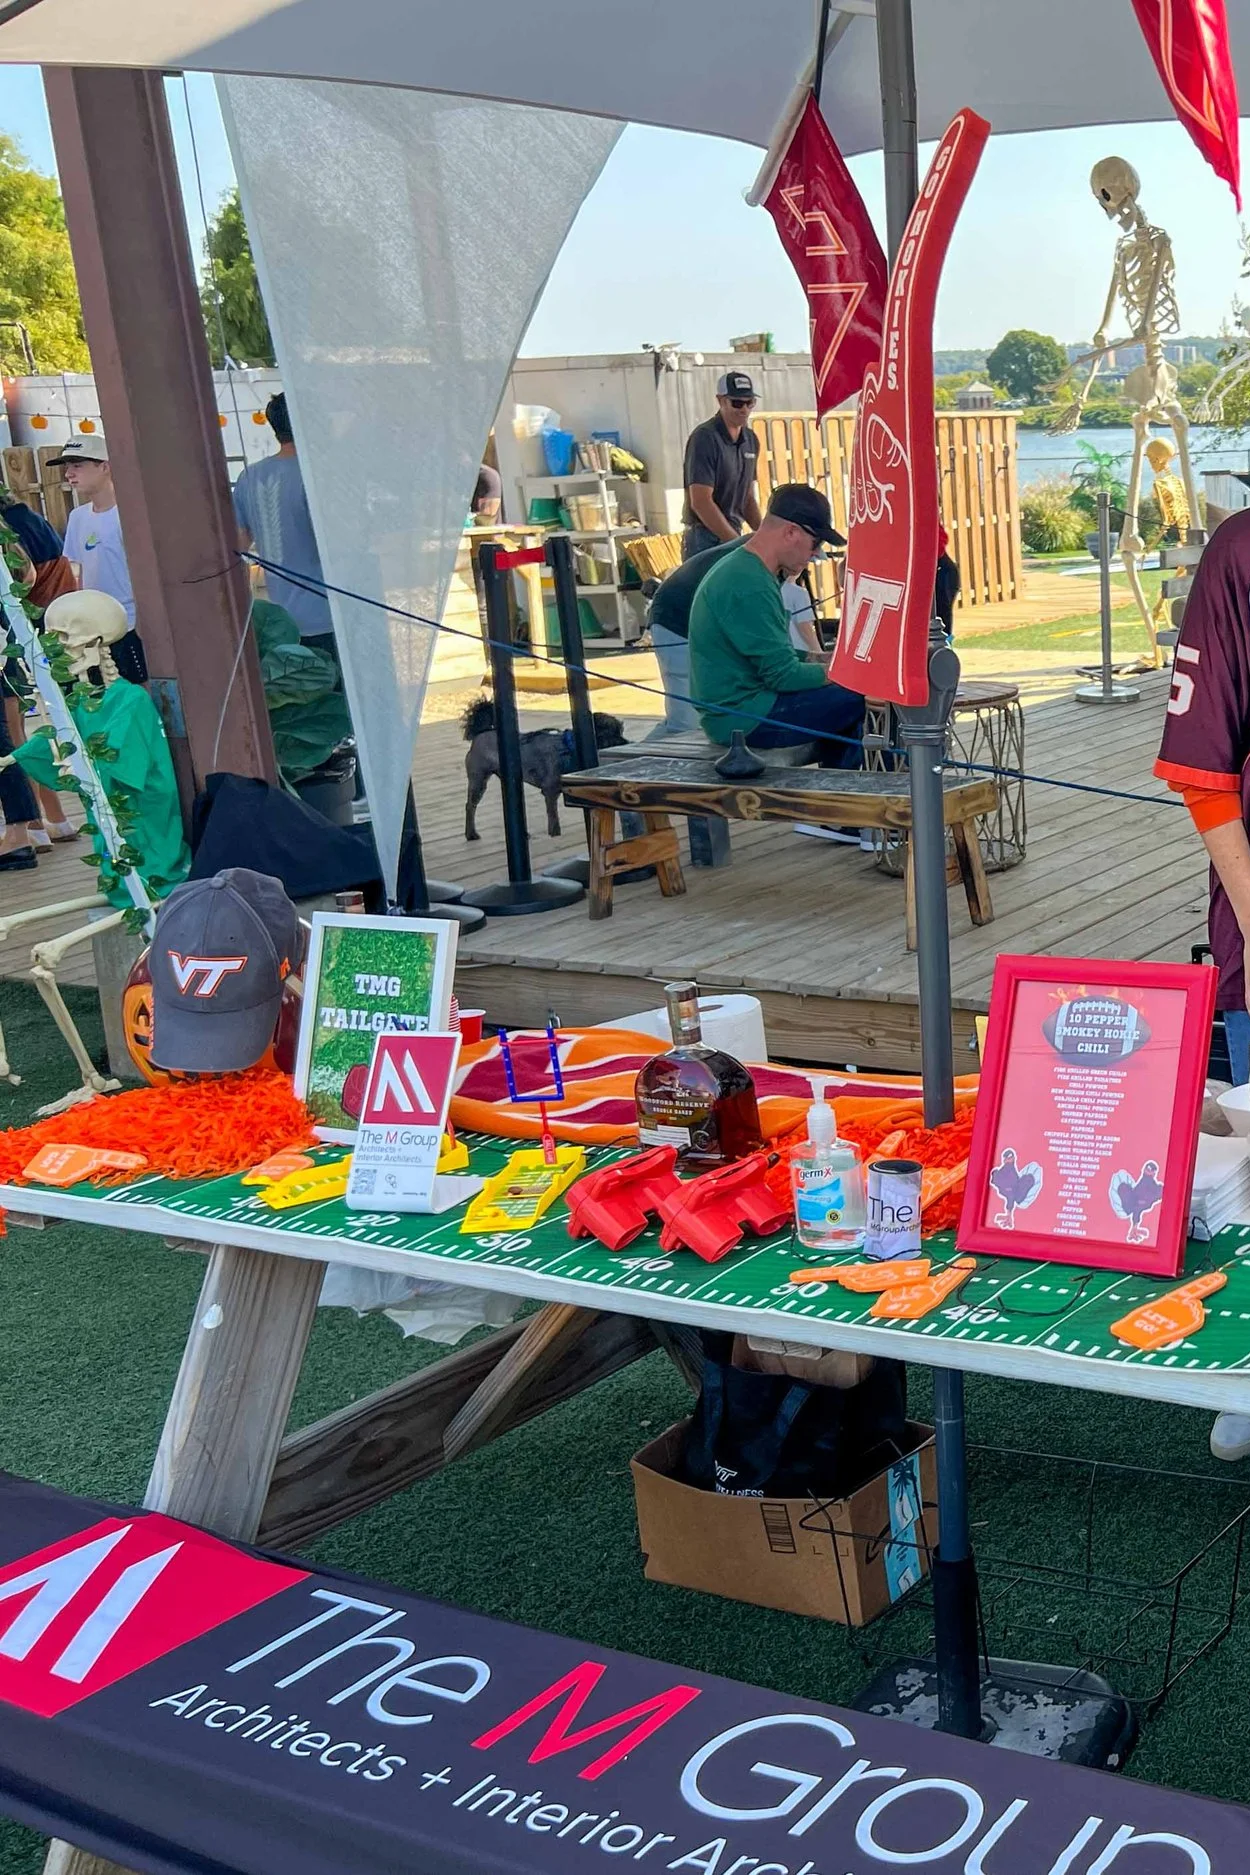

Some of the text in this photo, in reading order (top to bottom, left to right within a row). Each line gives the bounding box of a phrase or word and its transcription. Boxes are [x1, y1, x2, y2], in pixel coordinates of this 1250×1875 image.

[924, 145, 951, 199] GO
[844, 567, 906, 662] VT
[1167, 643, 1200, 716] 5
[167, 950, 248, 998] VT
[355, 973, 401, 998] TMG
[1069, 1013, 1128, 1026] 10 PEPPER
[1055, 1025, 1140, 1040] SMOKEY HOKIE
[1077, 1042, 1110, 1054] CHILI
[358, 1145, 396, 1153] Architects
[361, 1129, 438, 1151] The M Group
[357, 1153, 422, 1163] Interior Architects
[868, 1195, 913, 1223] The
[482, 1233, 533, 1253] 30
[618, 1256, 675, 1273] 40
[940, 1304, 1000, 1325] 40
[225, 1588, 491, 1726] The
[470, 1661, 702, 1781] M
[149, 1683, 409, 1783] Architects
[443, 1773, 677, 1858] Interior
